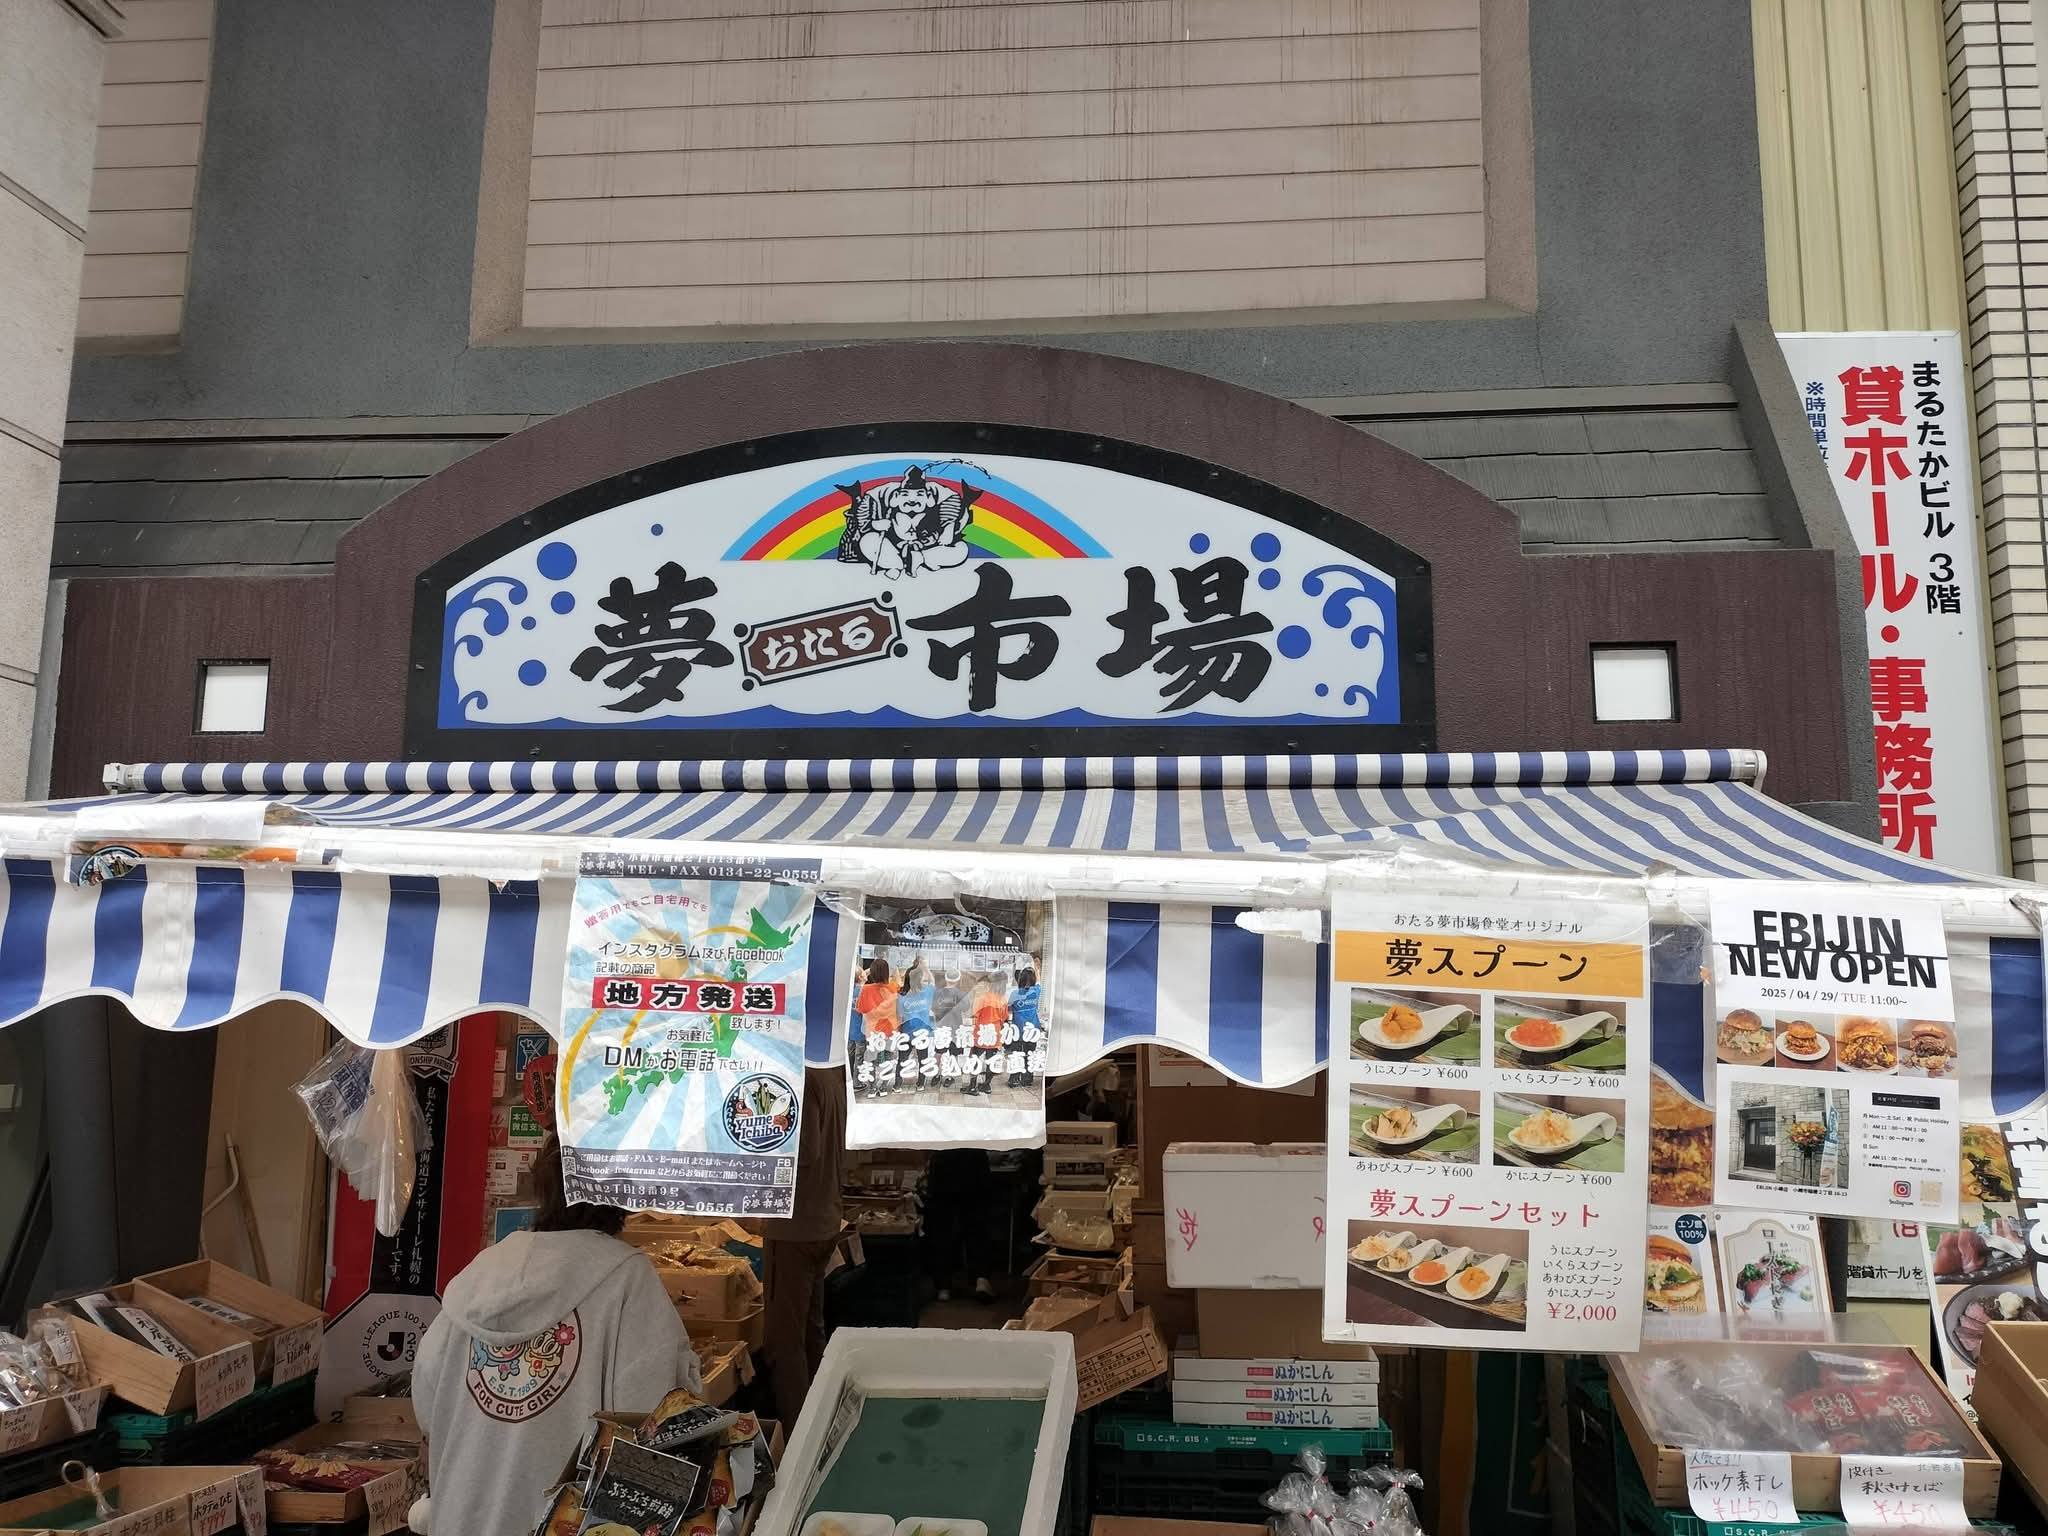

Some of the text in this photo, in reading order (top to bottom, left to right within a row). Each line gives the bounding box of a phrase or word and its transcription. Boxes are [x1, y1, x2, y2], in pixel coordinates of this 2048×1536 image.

[1912, 361, 1961, 614] まるたかビル 3階
[1838, 365, 1937, 860] 貸ホール・事務所
[571, 556, 1276, 712] 夢 おたる 市場
[708, 866, 819, 881] 0134-22-0555
[1393, 913, 1584, 935] おたる夢市場食堂オリジナル
[1753, 910, 1904, 956] EBIJIN
[1386, 938, 1587, 983] 夢スプーン
[1729, 945, 1937, 988] NEW OPEN
[595, 962, 656, 975] 記載の商品
[605, 980, 776, 1011] 地方発送
[1761, 988, 1787, 998] 2025
[666, 1029, 714, 1042] お気軽に
[1363, 1063, 1469, 1080] うにスプーン ¥600
[1501, 1073, 1620, 1089] いくらスプーン ¥600
[735, 1115, 773, 1130] Yume
[741, 1125, 783, 1139] Ichiba
[777, 1158, 791, 1167] FB
[1356, 1160, 1473, 1178] あわびスプーン ¥600
[1505, 1171, 1613, 1186] かにスプーン ¥600
[627, 1196, 735, 1214] 0134-22-0555
[1370, 1188, 1600, 1228] 夢スプーンセット
[1679, 1230, 1705, 1240] 100%
[1549, 1245, 1618, 1258] うにスプーン
[1542, 1259, 1624, 1272] いくらスプーン
[1542, 1273, 1623, 1286] あわびスプーン
[1547, 1287, 1616, 1300] かにスプーン
[403, 1312, 419, 1324] 100
[1548, 1302, 1617, 1322] ¥2,000
[1275, 1365, 1334, 1380] ぬかにしん
[474, 1382, 561, 1416] FOR CUTE GIRL
[1273, 1387, 1333, 1402] ぬかにしん
[1274, 1409, 1334, 1424] ぬかにしん
[1693, 1470, 1783, 1492] ホッケ素干し
[1713, 1498, 1778, 1520] ¥450
